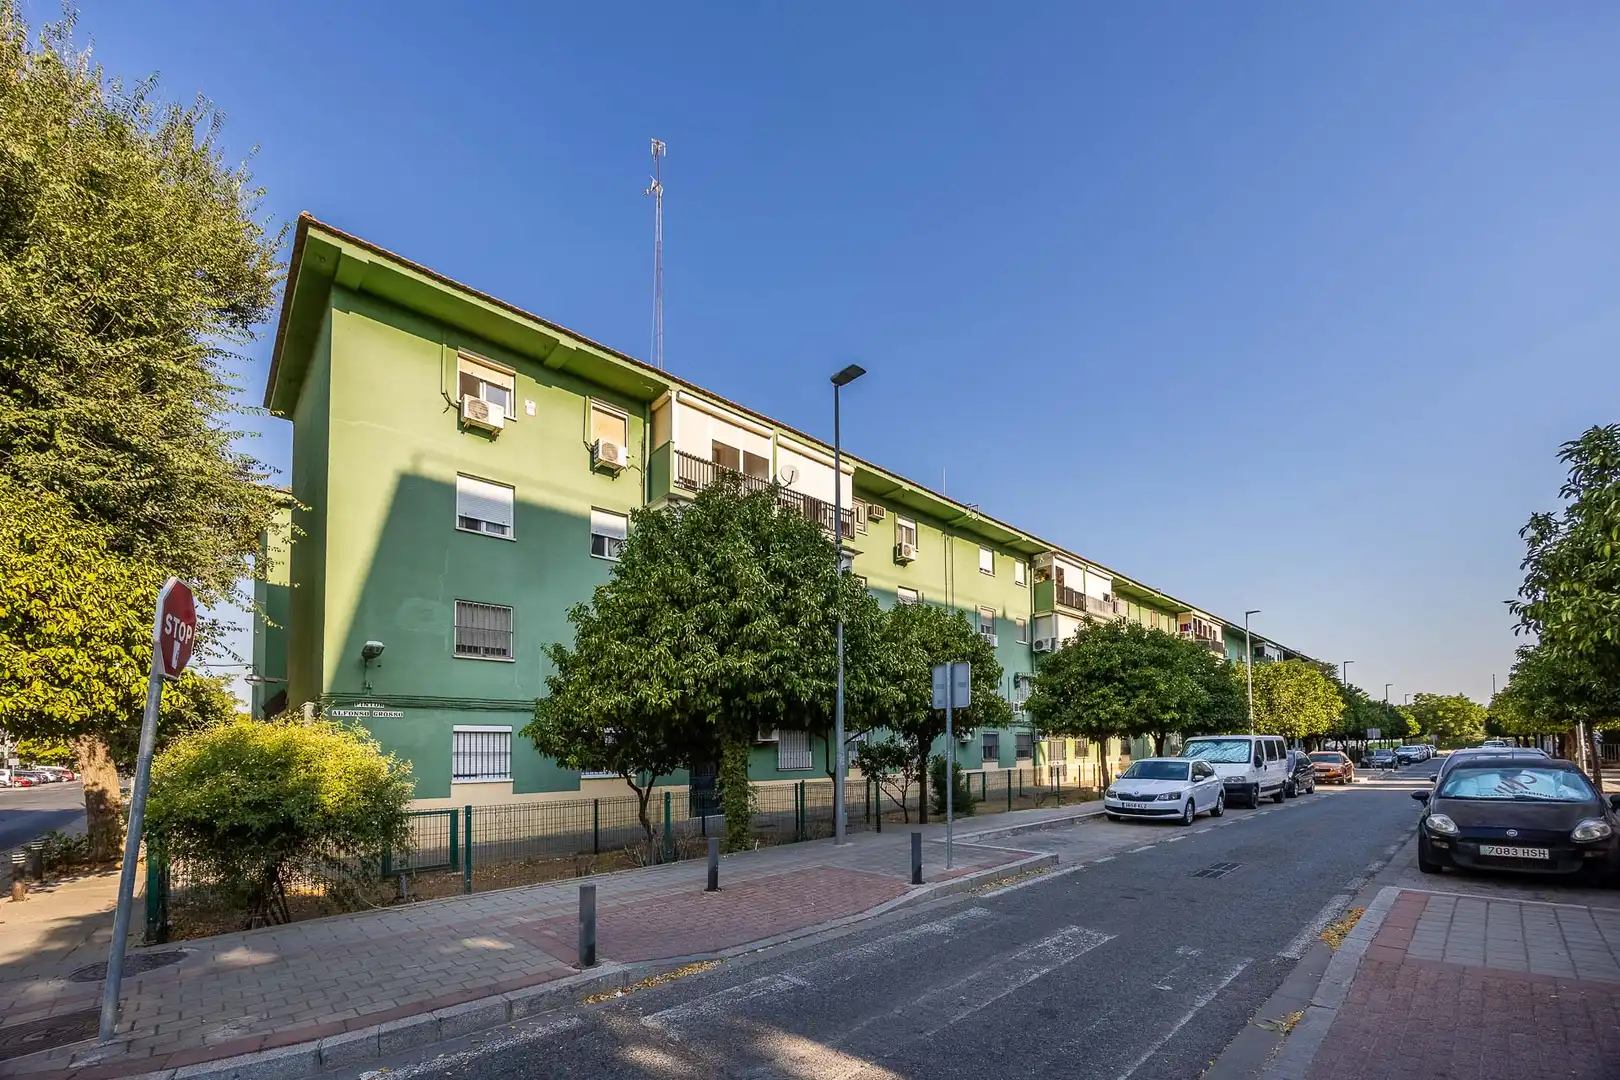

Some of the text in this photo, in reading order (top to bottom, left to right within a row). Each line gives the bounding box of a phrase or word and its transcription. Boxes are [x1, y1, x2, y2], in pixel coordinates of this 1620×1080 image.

[164, 613, 193, 645] STOP
[1488, 846, 1546, 858] 7083 HSH
